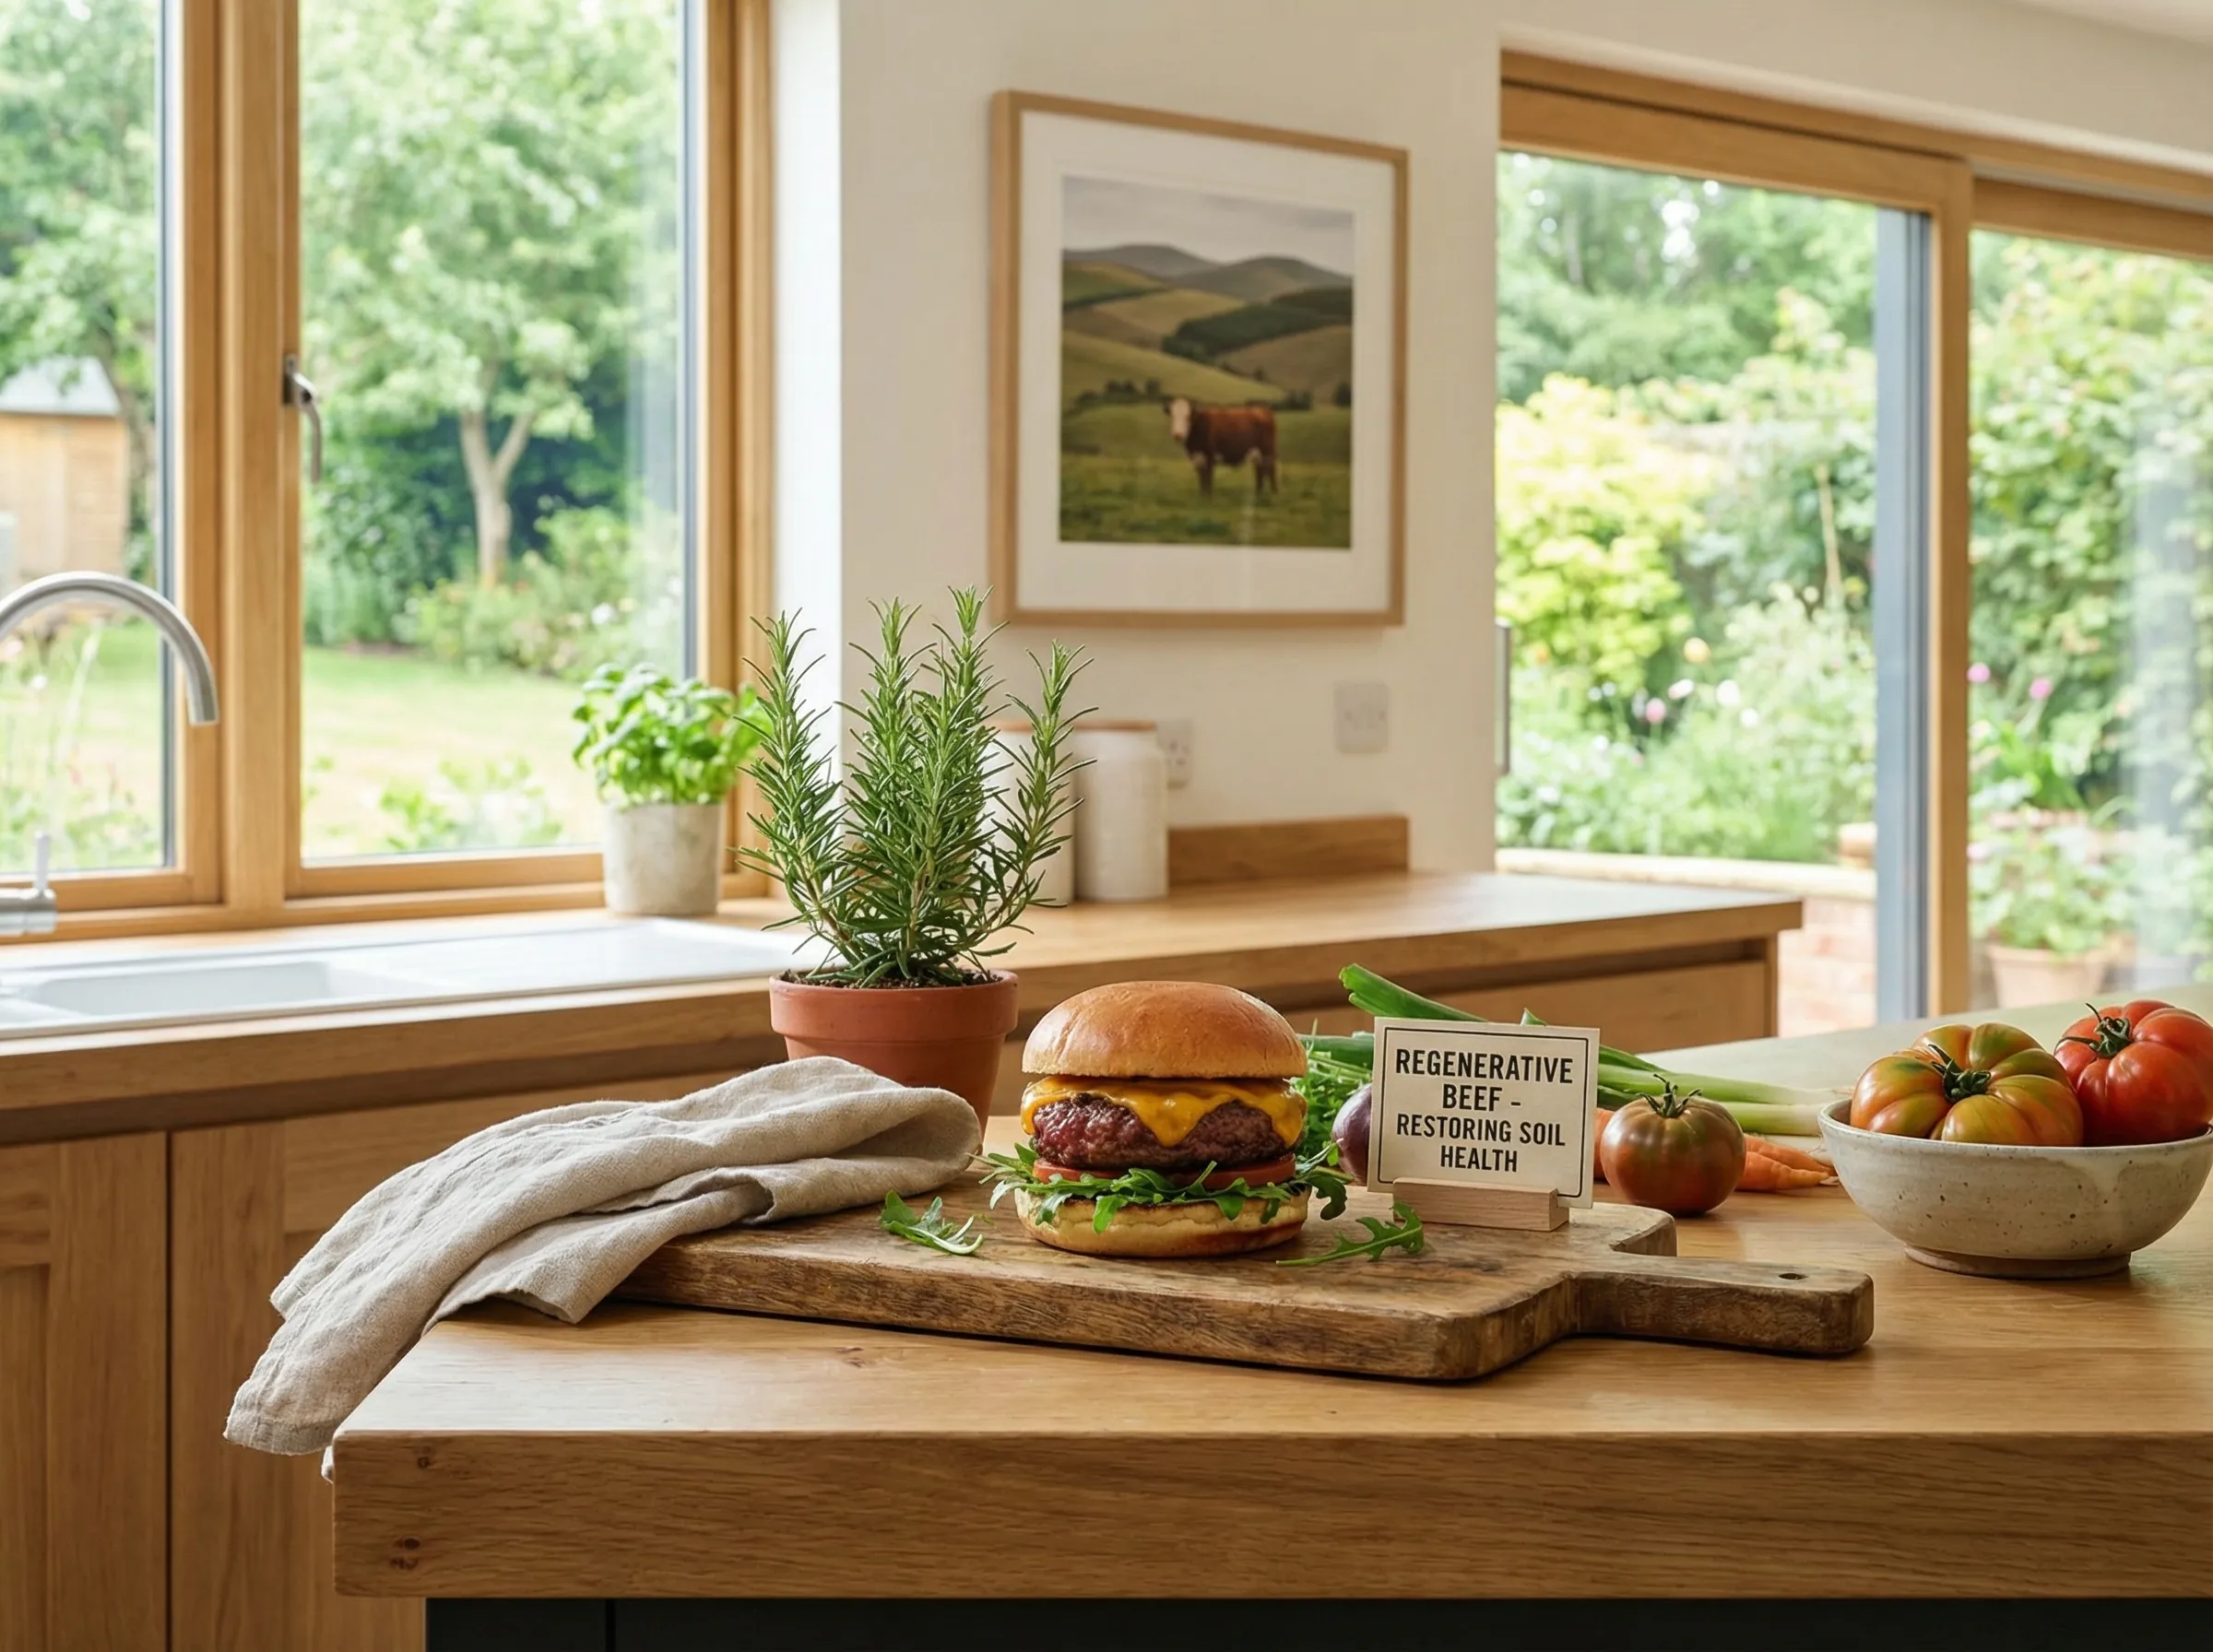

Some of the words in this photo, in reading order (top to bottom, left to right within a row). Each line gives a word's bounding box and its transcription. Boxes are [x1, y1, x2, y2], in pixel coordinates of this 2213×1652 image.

[1395, 1048, 1573, 1083] REGENERATIVE
[1442, 1083, 1502, 1112] BEEF
[1396, 1113, 1512, 1143] RESTORING
[1519, 1121, 1566, 1146] SOIL
[1440, 1145, 1518, 1173] HEALTH
